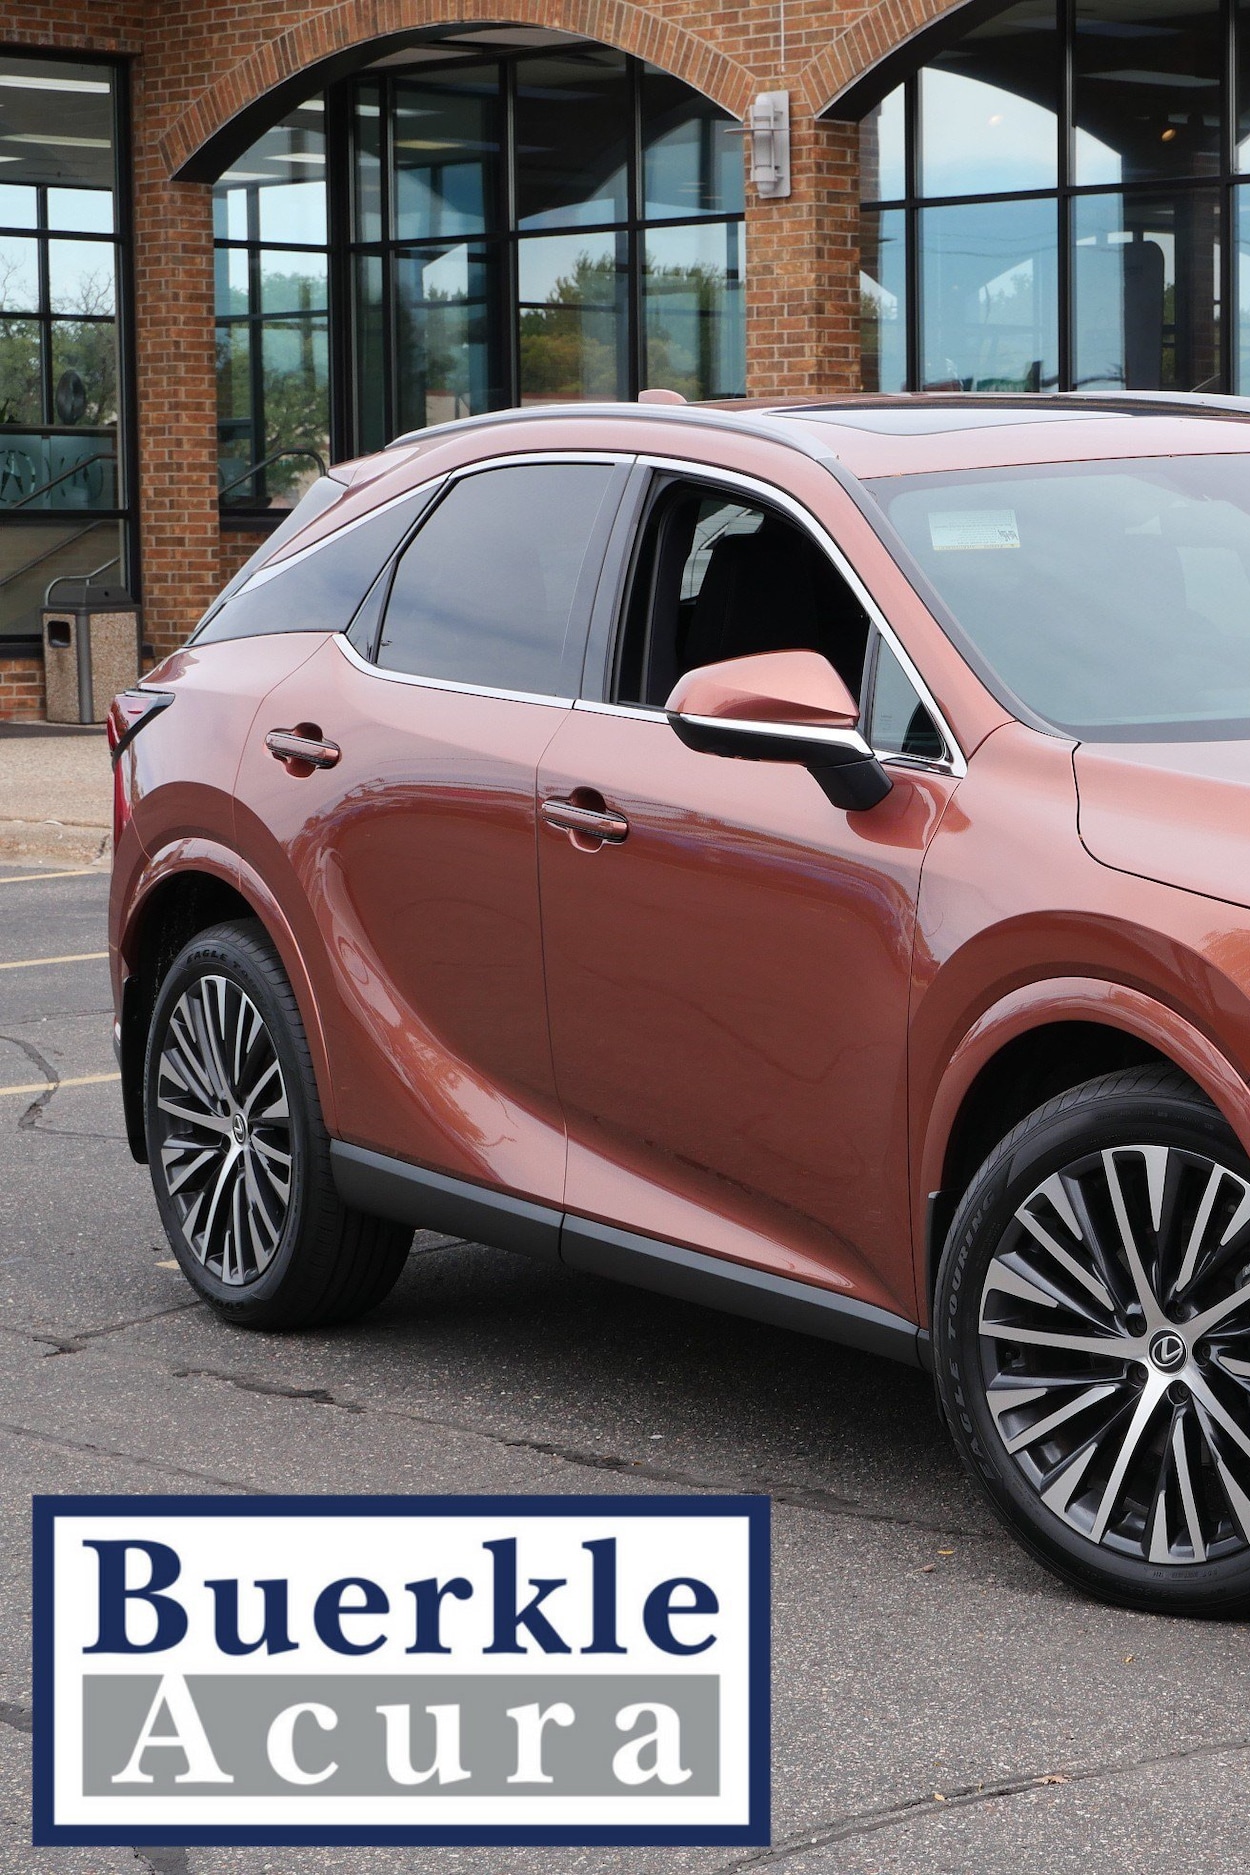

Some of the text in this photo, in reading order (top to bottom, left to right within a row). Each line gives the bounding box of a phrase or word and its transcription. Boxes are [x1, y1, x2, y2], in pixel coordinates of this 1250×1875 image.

[186, 949, 228, 965] EAGLE
[948, 1190, 993, 1340] TOURING
[949, 1357, 996, 1480] EAGLE
